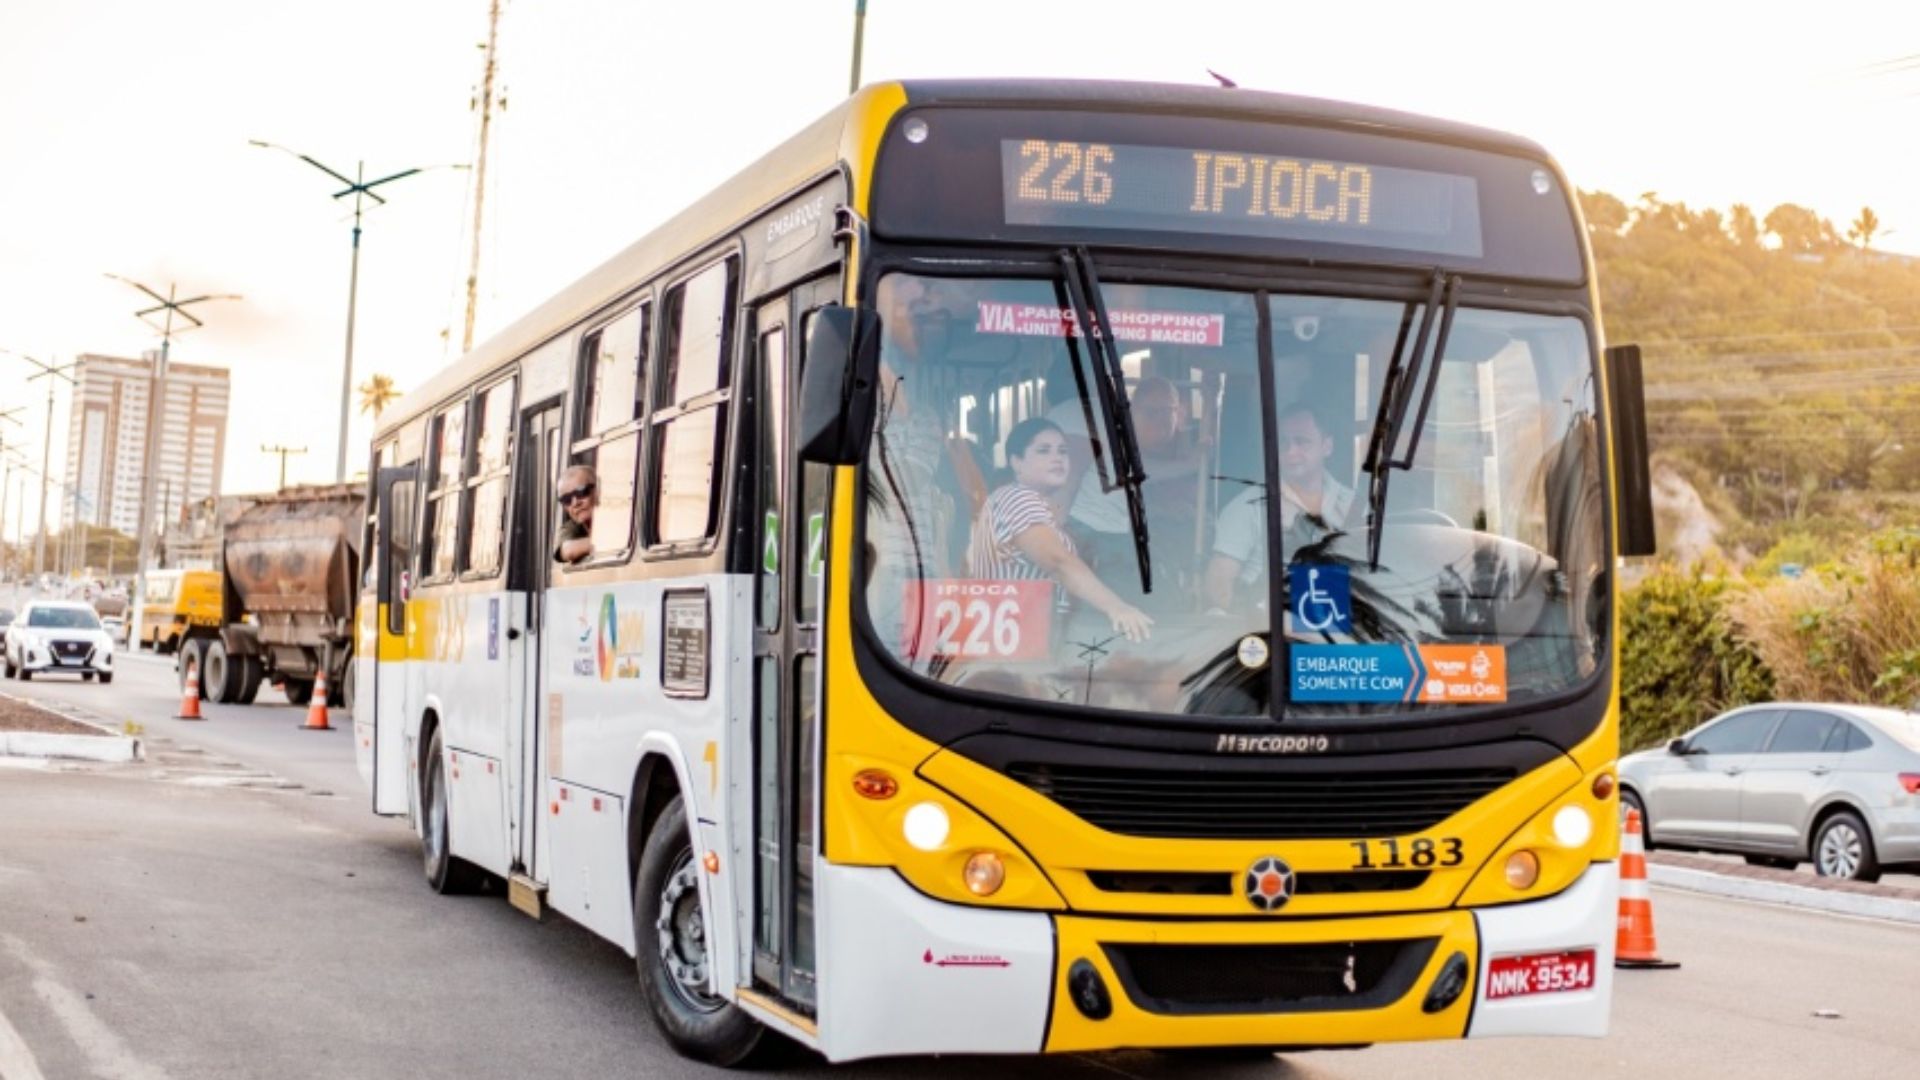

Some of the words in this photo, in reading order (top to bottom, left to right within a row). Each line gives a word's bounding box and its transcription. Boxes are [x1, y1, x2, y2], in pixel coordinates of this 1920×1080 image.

[1018, 139, 1114, 205] 226
[1190, 152, 1373, 224] IPIOCA
[936, 584, 1019, 596] IPIOCA
[933, 599, 1021, 656] 226
[1296, 656, 1379, 674] EMBARQUE
[1297, 676, 1368, 690] SOMENTE
[1370, 677, 1404, 691] COM
[1351, 837, 1464, 868] 1183
[1490, 961, 1590, 997] NMK-9534
